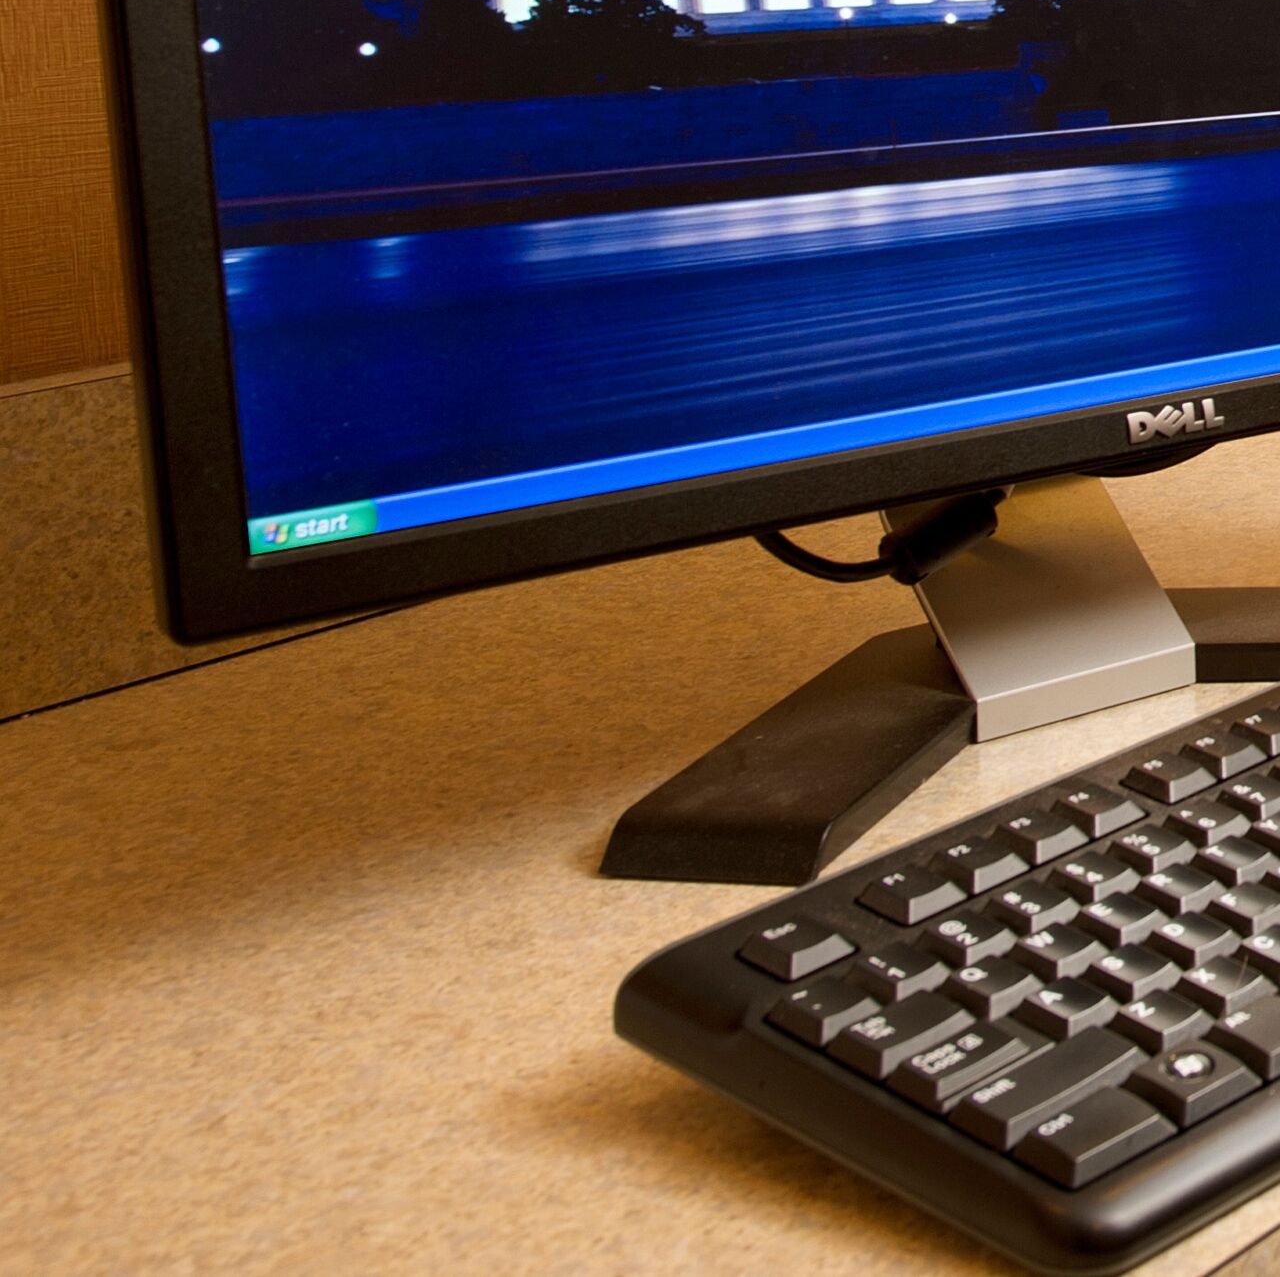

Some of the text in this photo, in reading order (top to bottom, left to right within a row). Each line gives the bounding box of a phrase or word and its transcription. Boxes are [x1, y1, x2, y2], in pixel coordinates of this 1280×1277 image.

[1126, 397, 1225, 445] DELL
[294, 513, 348, 539] start
[1009, 817, 1032, 829] F3
[1198, 817, 1217, 828] 6
[1260, 819, 1279, 831] Y
[947, 844, 971, 858] F2
[1141, 843, 1161, 855] 5
[1205, 845, 1225, 858] T
[882, 872, 906, 887] F1
[1086, 871, 1104, 883] 4
[1149, 873, 1173, 887] R
[1020, 901, 1042, 914] 3
[1219, 893, 1237, 908] F
[1089, 902, 1114, 918] E
[762, 922, 798, 941] Esc
[938, 919, 967, 936] @
[1161, 923, 1185, 938] D
[956, 932, 979, 946] 2
[1026, 930, 1055, 948] W
[1252, 935, 1275, 950] C
[1101, 955, 1125, 971] S
[959, 966, 989, 982] Q
[1192, 967, 1217, 984] X
[1038, 989, 1064, 1006] A
[1128, 1001, 1156, 1019] Z
[911, 1043, 957, 1068] Caps
[921, 1050, 967, 1075] Lock
[972, 1077, 1017, 1104] Shift
[1037, 1113, 1075, 1137] Ctrl
